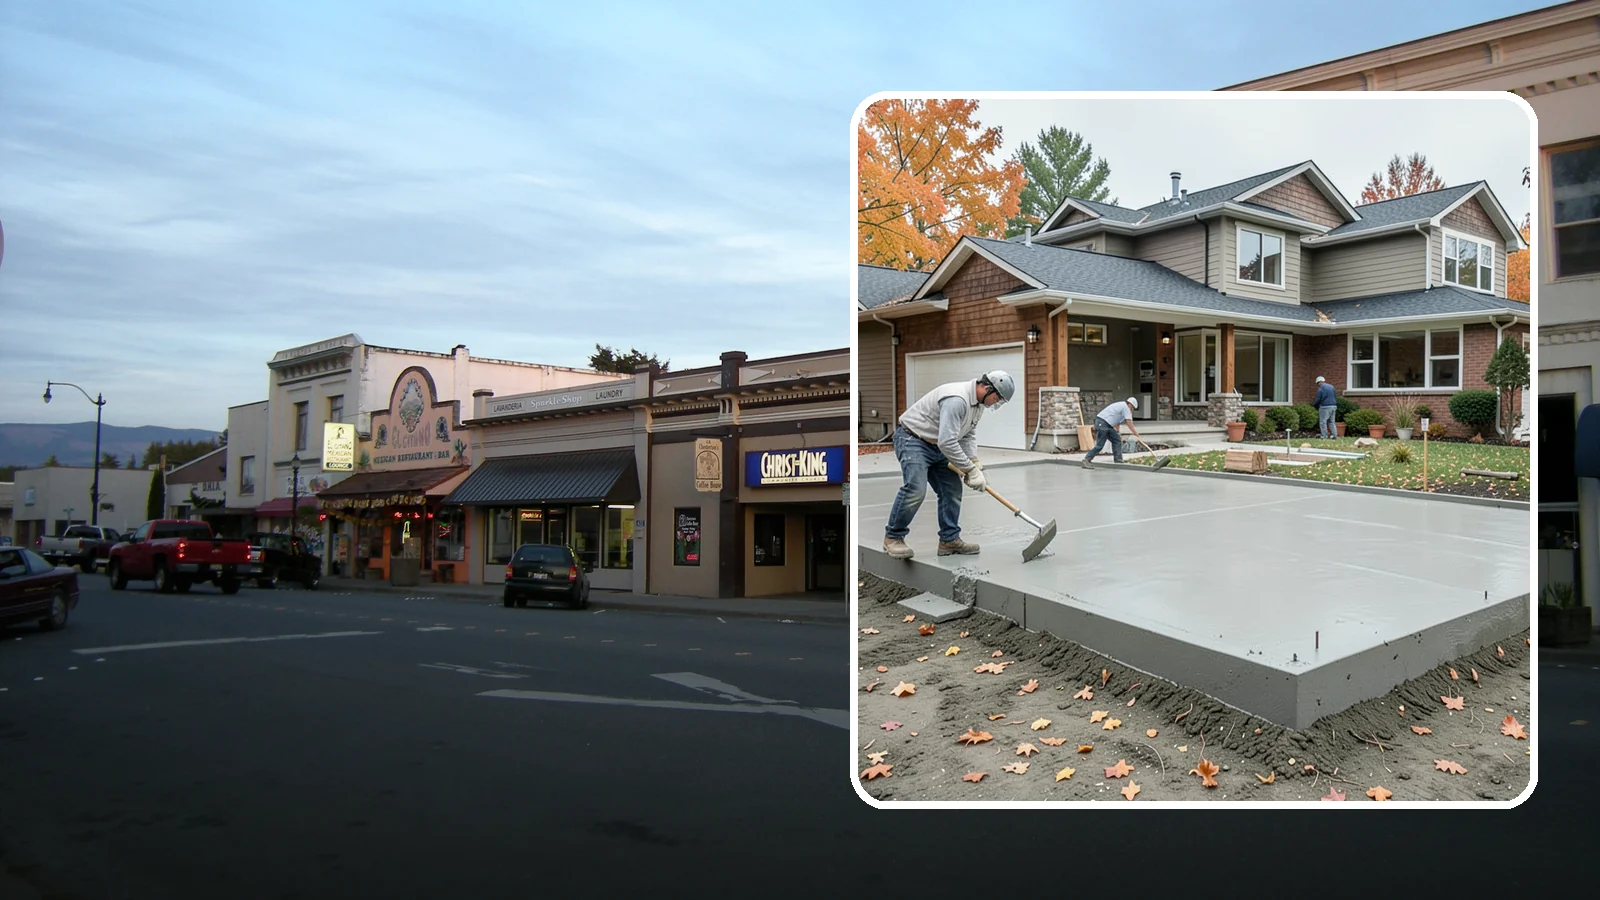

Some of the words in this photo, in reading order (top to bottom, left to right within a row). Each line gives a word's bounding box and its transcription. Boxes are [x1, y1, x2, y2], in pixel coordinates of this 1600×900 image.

[595, 389, 623, 400] LAUNDRY
[493, 401, 522, 413] LAVANDERIA
[531, 399, 561, 409] Sparkle
[562, 394, 582, 405] Shop
[374, 454, 396, 464] MEXICAN
[397, 451, 434, 462] RESTAURANT
[438, 450, 450, 459] BAR
